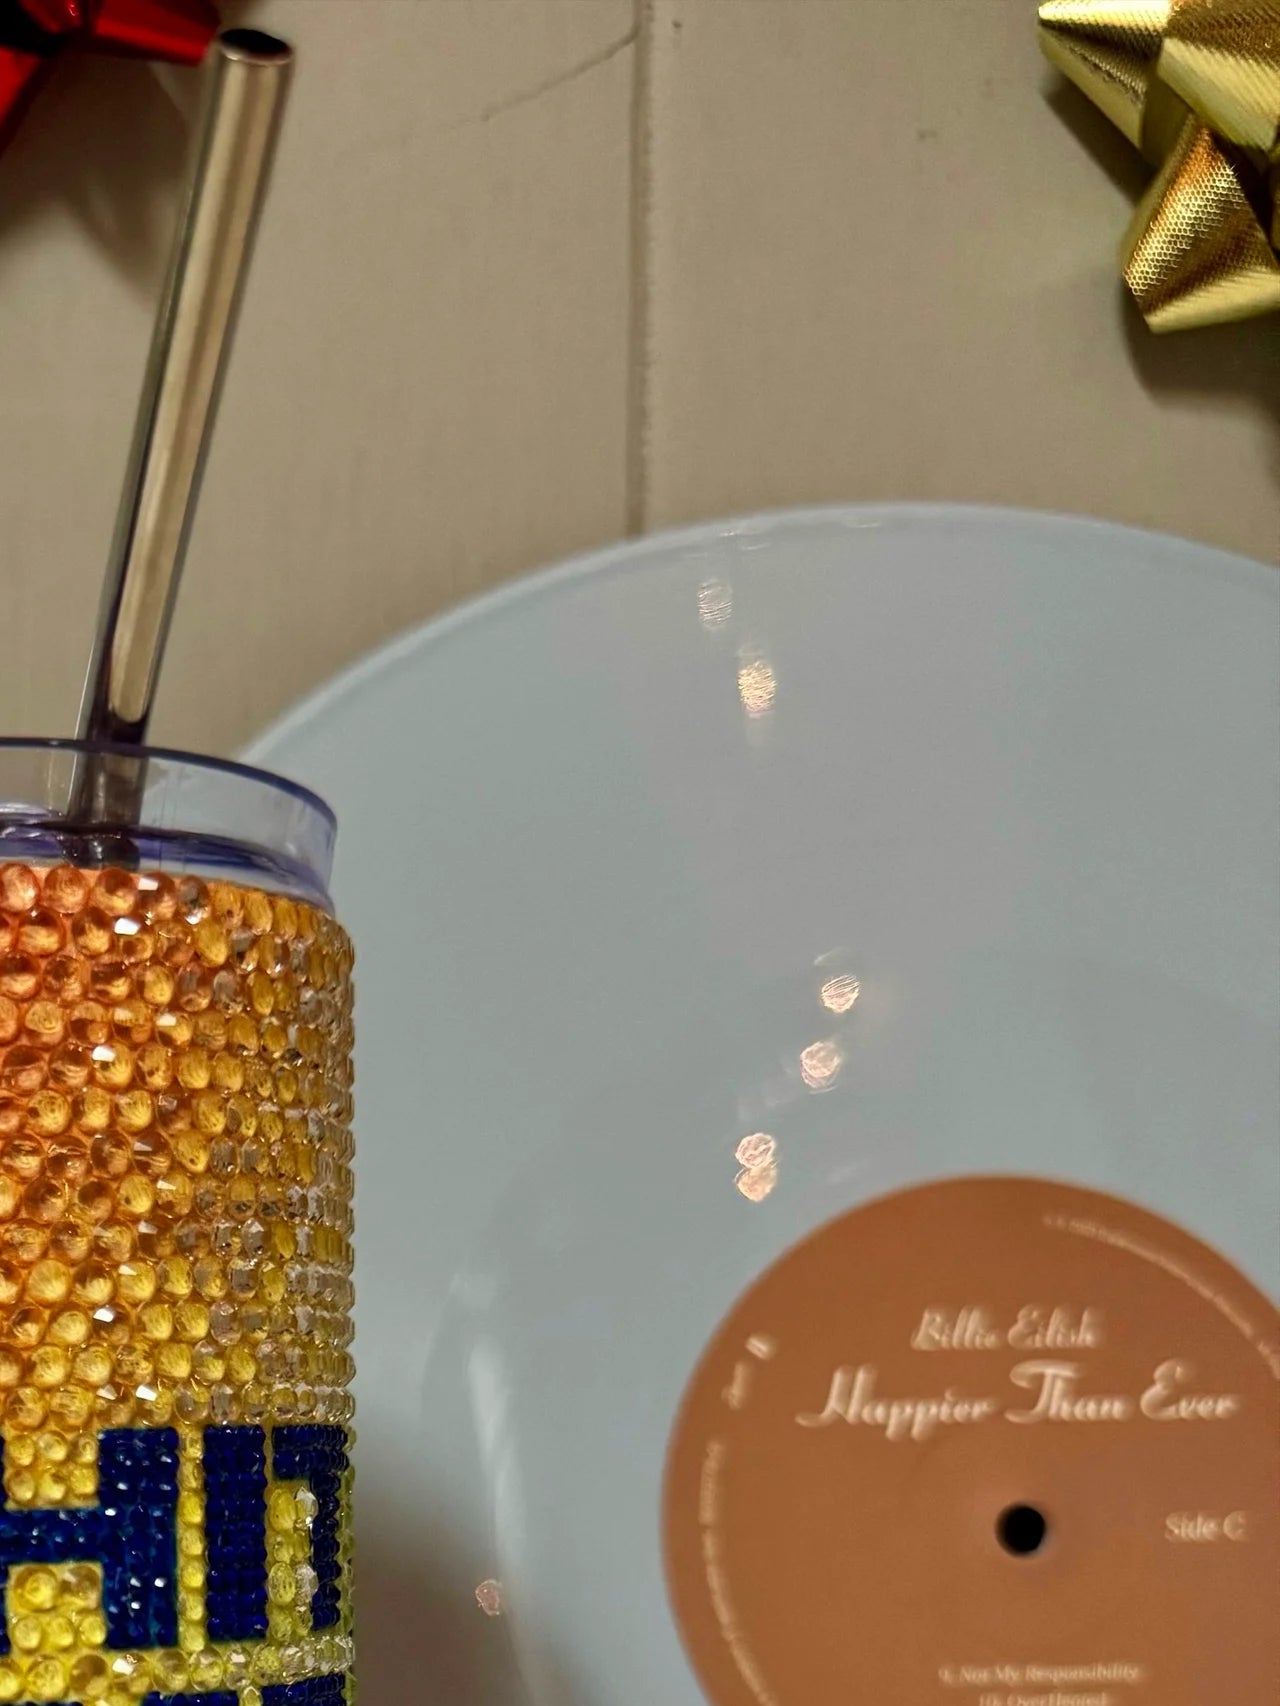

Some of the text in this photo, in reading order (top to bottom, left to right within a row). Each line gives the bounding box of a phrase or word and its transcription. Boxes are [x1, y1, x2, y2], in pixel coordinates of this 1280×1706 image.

[911, 1304, 1101, 1351] Billie Eilish
[795, 1358, 1241, 1440] Happier Than Ever
[1166, 1512, 1217, 1540] Side
